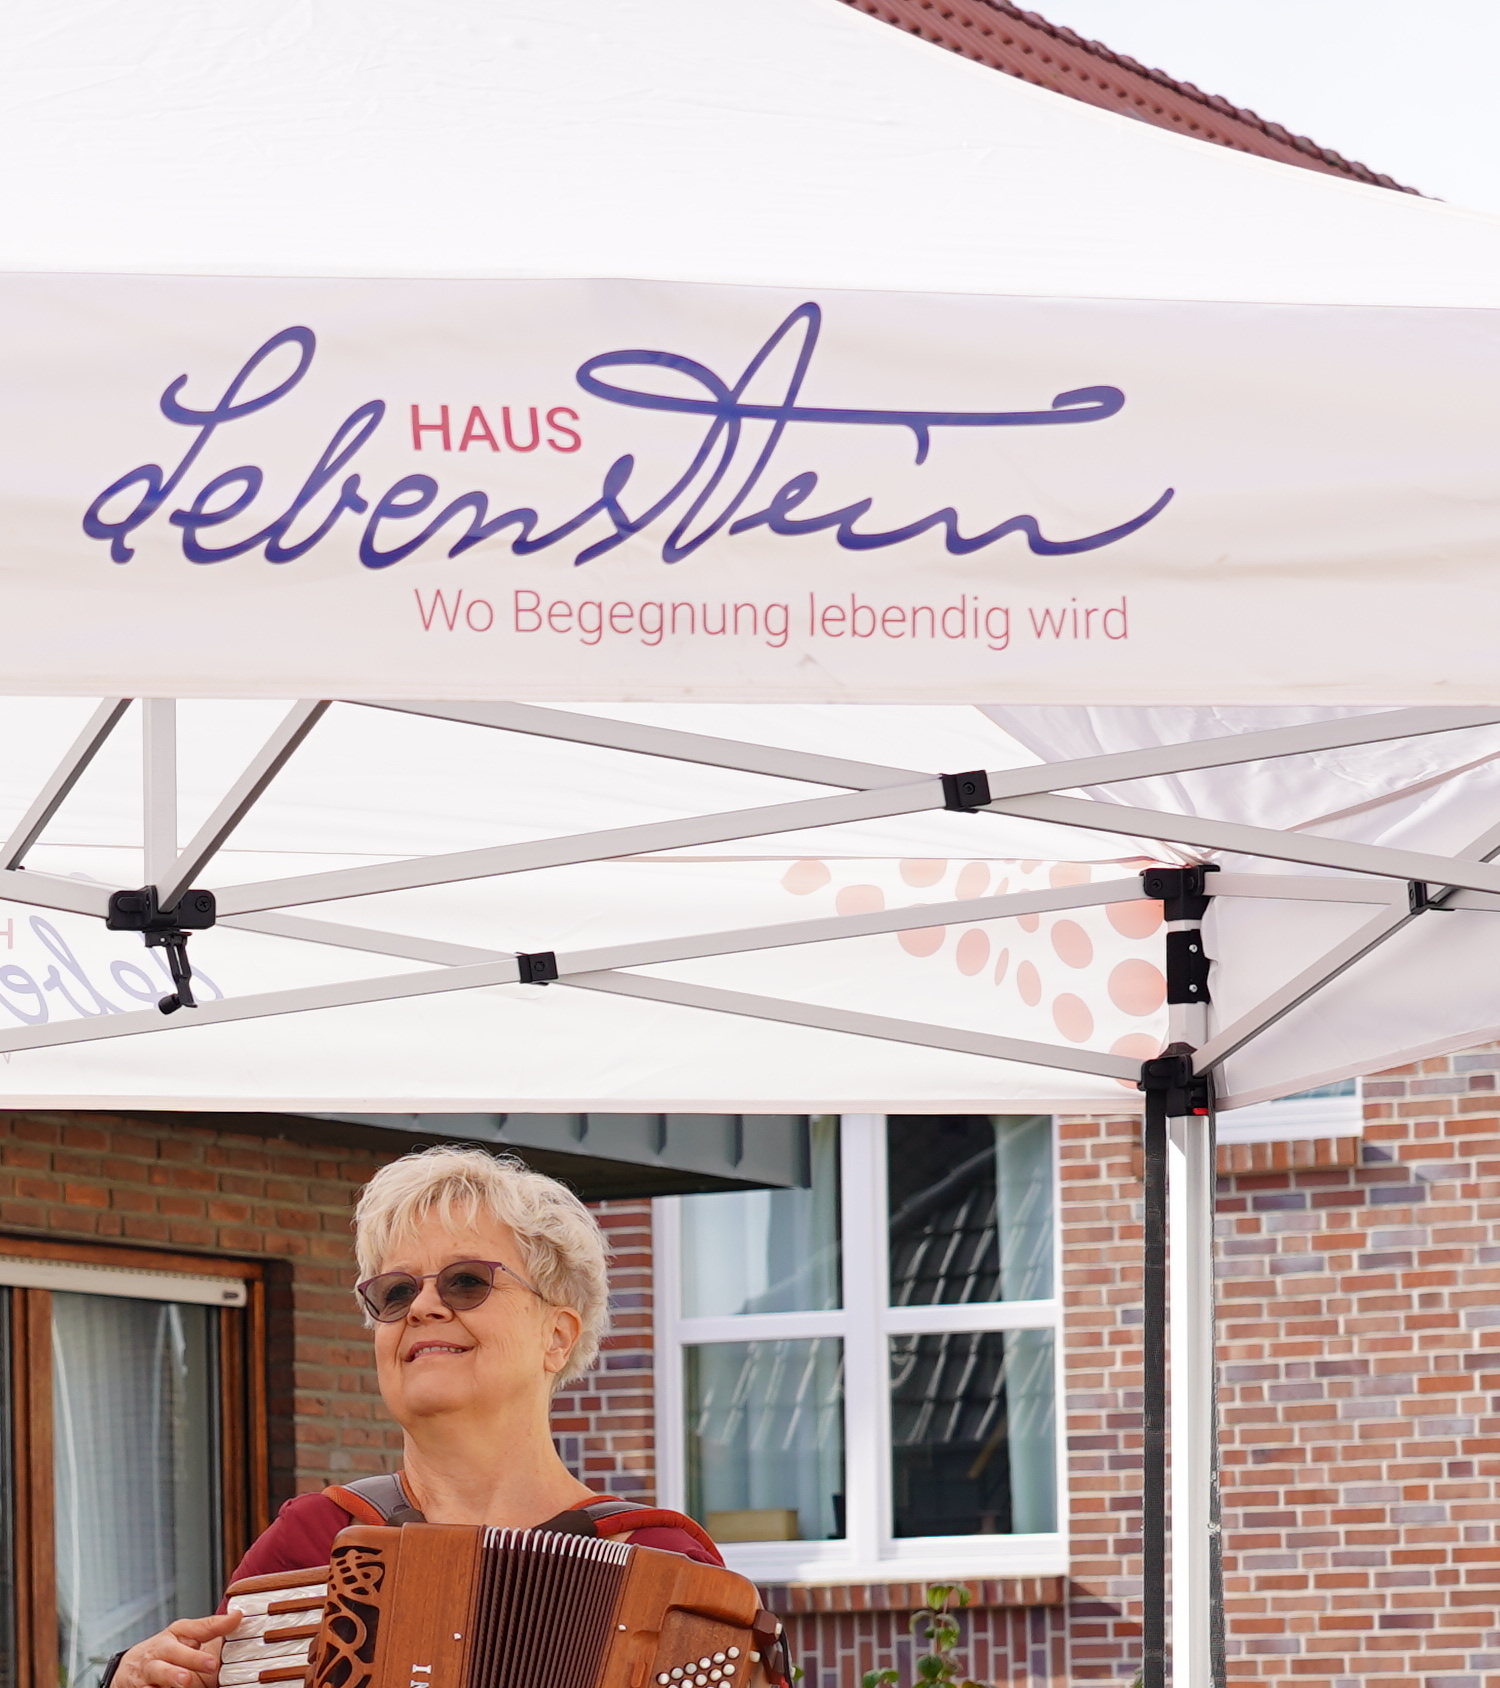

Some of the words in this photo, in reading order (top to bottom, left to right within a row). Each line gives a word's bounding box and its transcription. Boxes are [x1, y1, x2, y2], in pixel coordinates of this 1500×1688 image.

[410, 403, 583, 454] HAUS
[414, 589, 494, 633] Wo
[514, 589, 790, 649] Begegnung
[810, 593, 1010, 651] lebendig
[1029, 596, 1129, 640] wird
